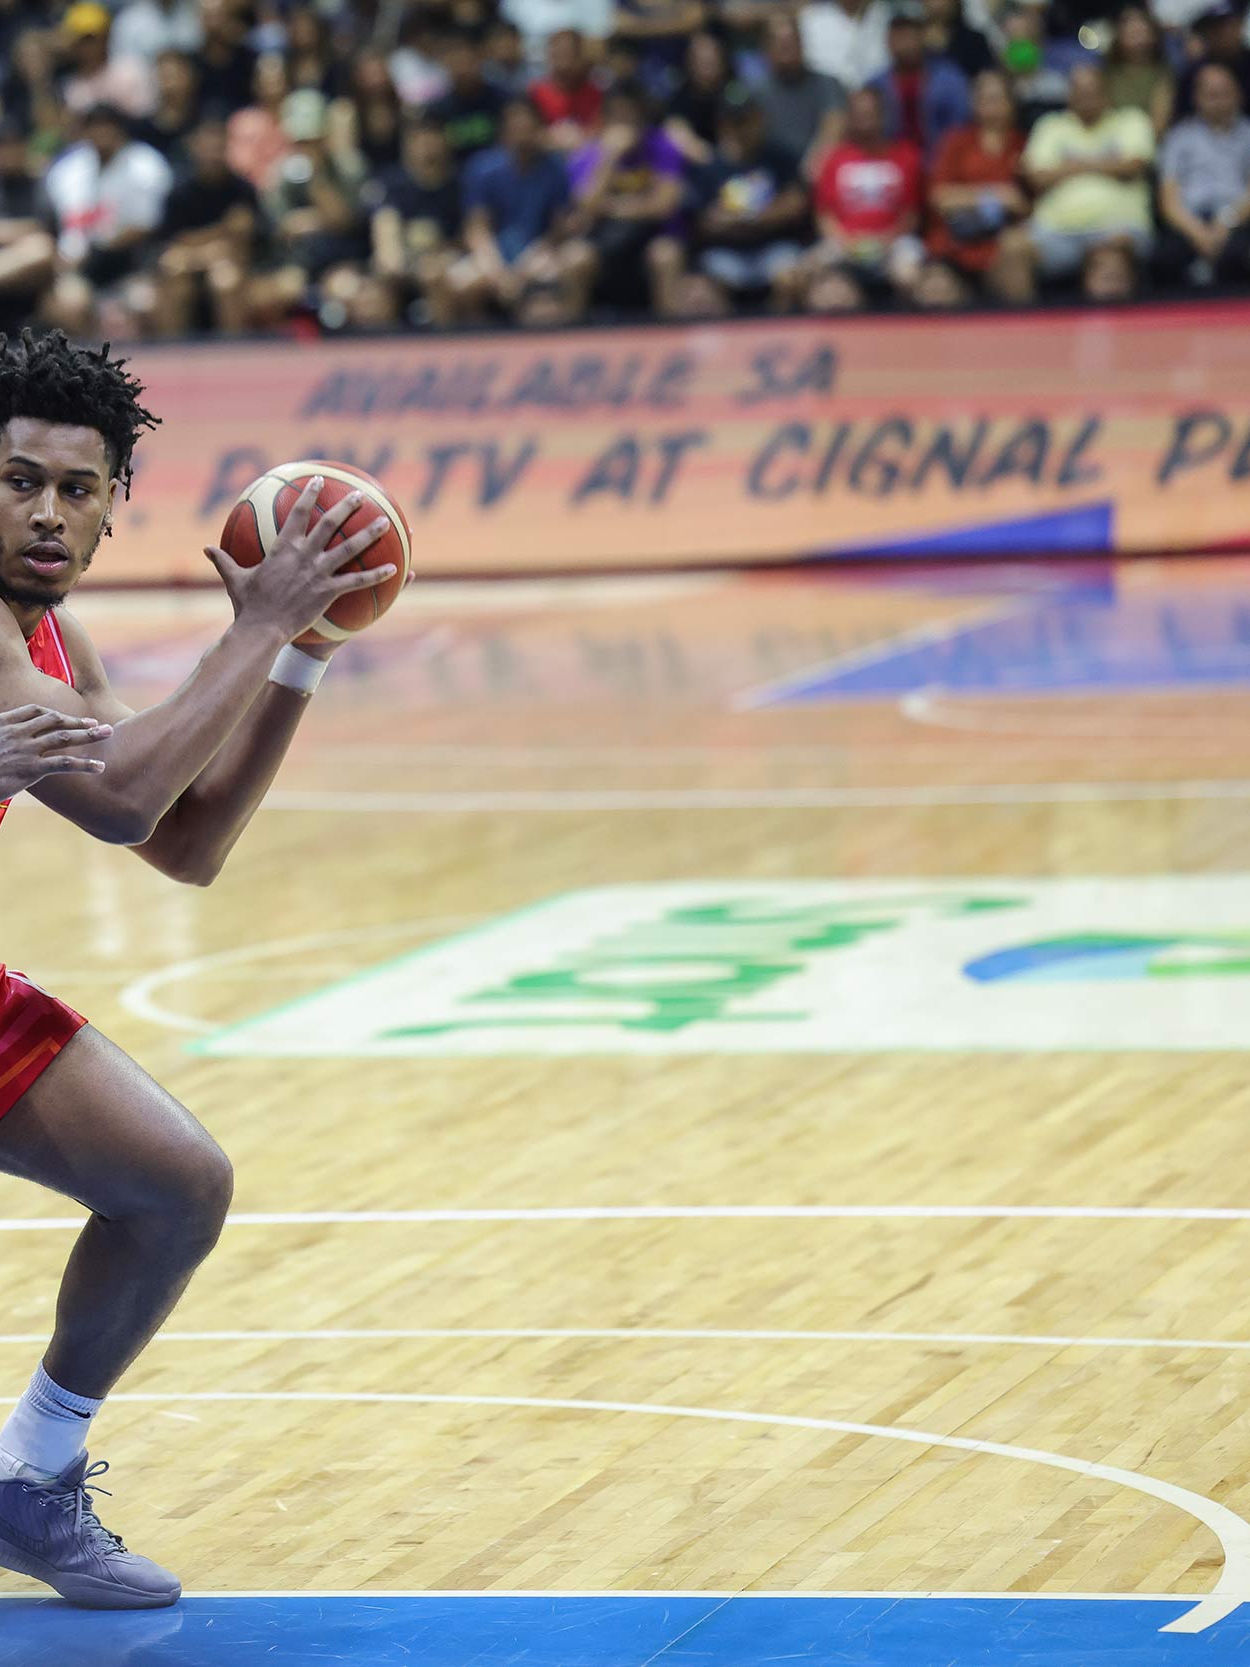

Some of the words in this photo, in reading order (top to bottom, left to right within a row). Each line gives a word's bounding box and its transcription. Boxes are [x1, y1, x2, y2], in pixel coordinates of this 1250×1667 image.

[735, 341, 840, 404] SA
[416, 434, 538, 508] TV
[568, 430, 706, 508] AT
[748, 410, 1108, 502] CIGNAL
